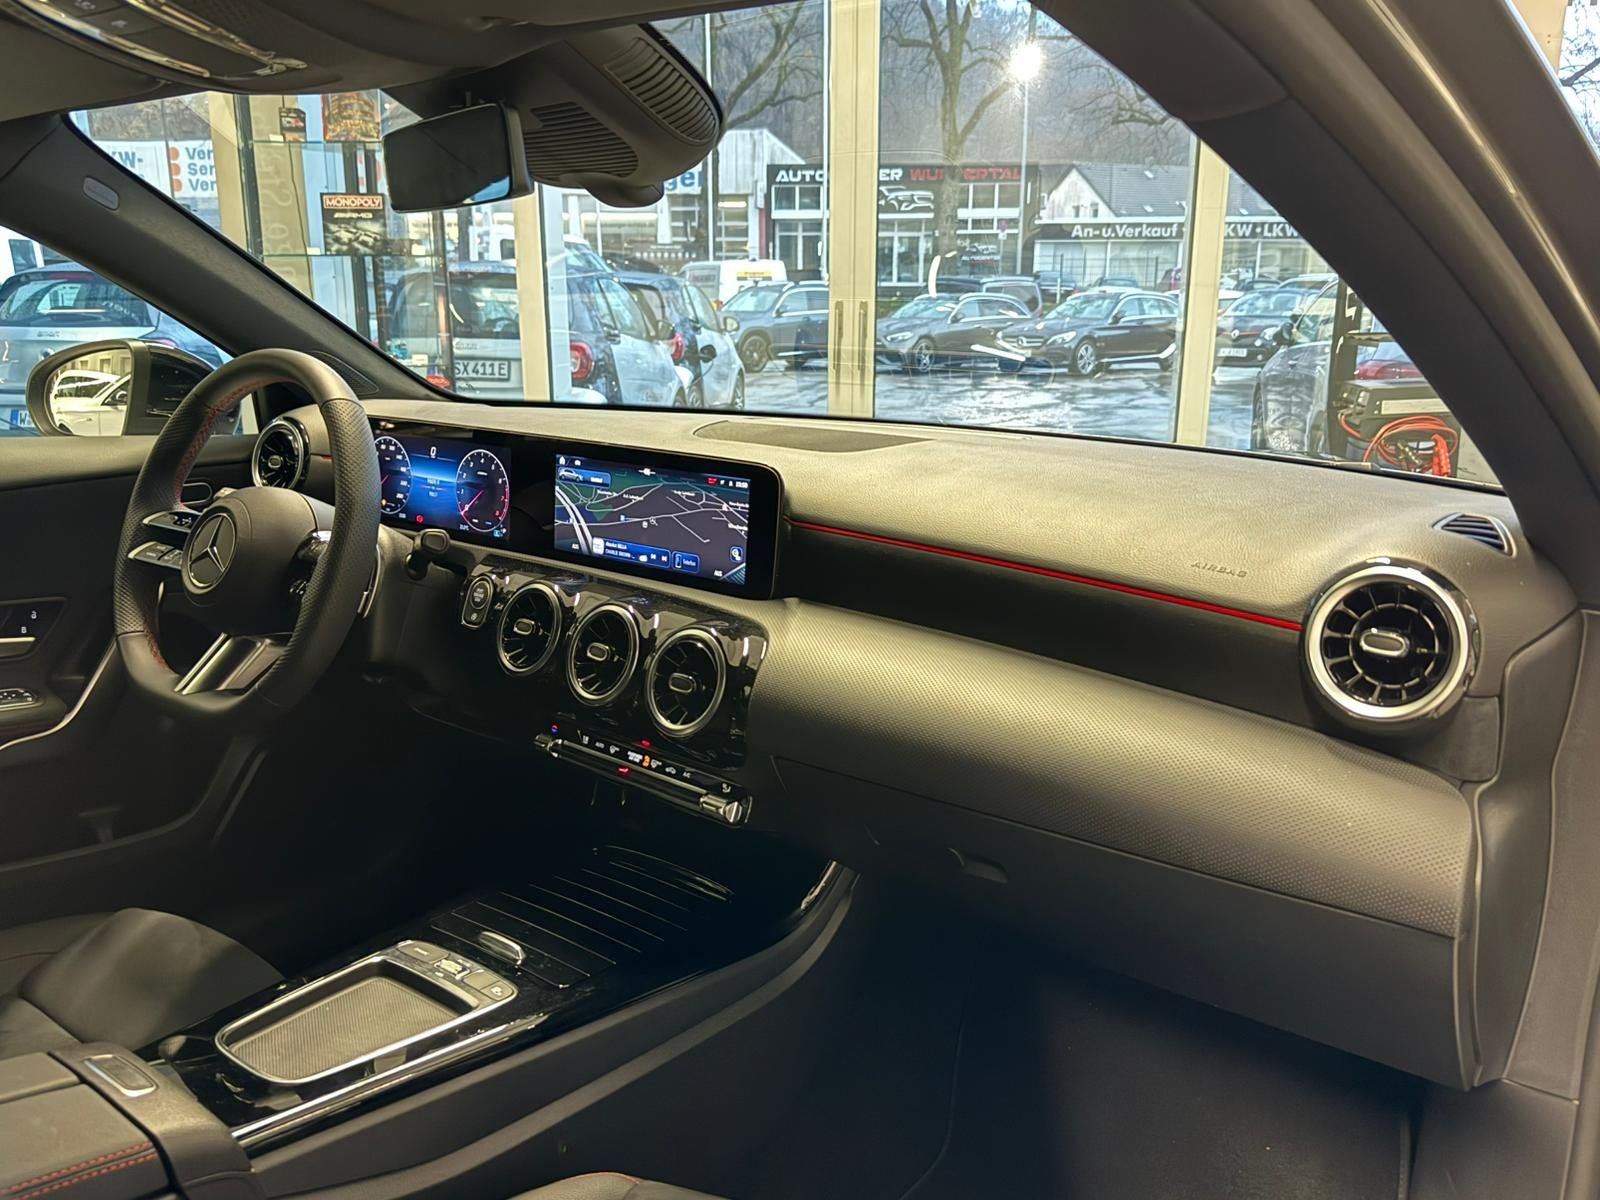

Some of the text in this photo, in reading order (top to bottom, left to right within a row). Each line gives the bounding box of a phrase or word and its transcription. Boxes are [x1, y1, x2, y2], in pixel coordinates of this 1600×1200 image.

[112, 150, 144, 168] W-
[325, 197, 380, 207] MONOPOLY
[1263, 223, 1299, 237] LKW
[430, 446, 437, 456] 0
[1190, 562, 1248, 578] AIRBAG
